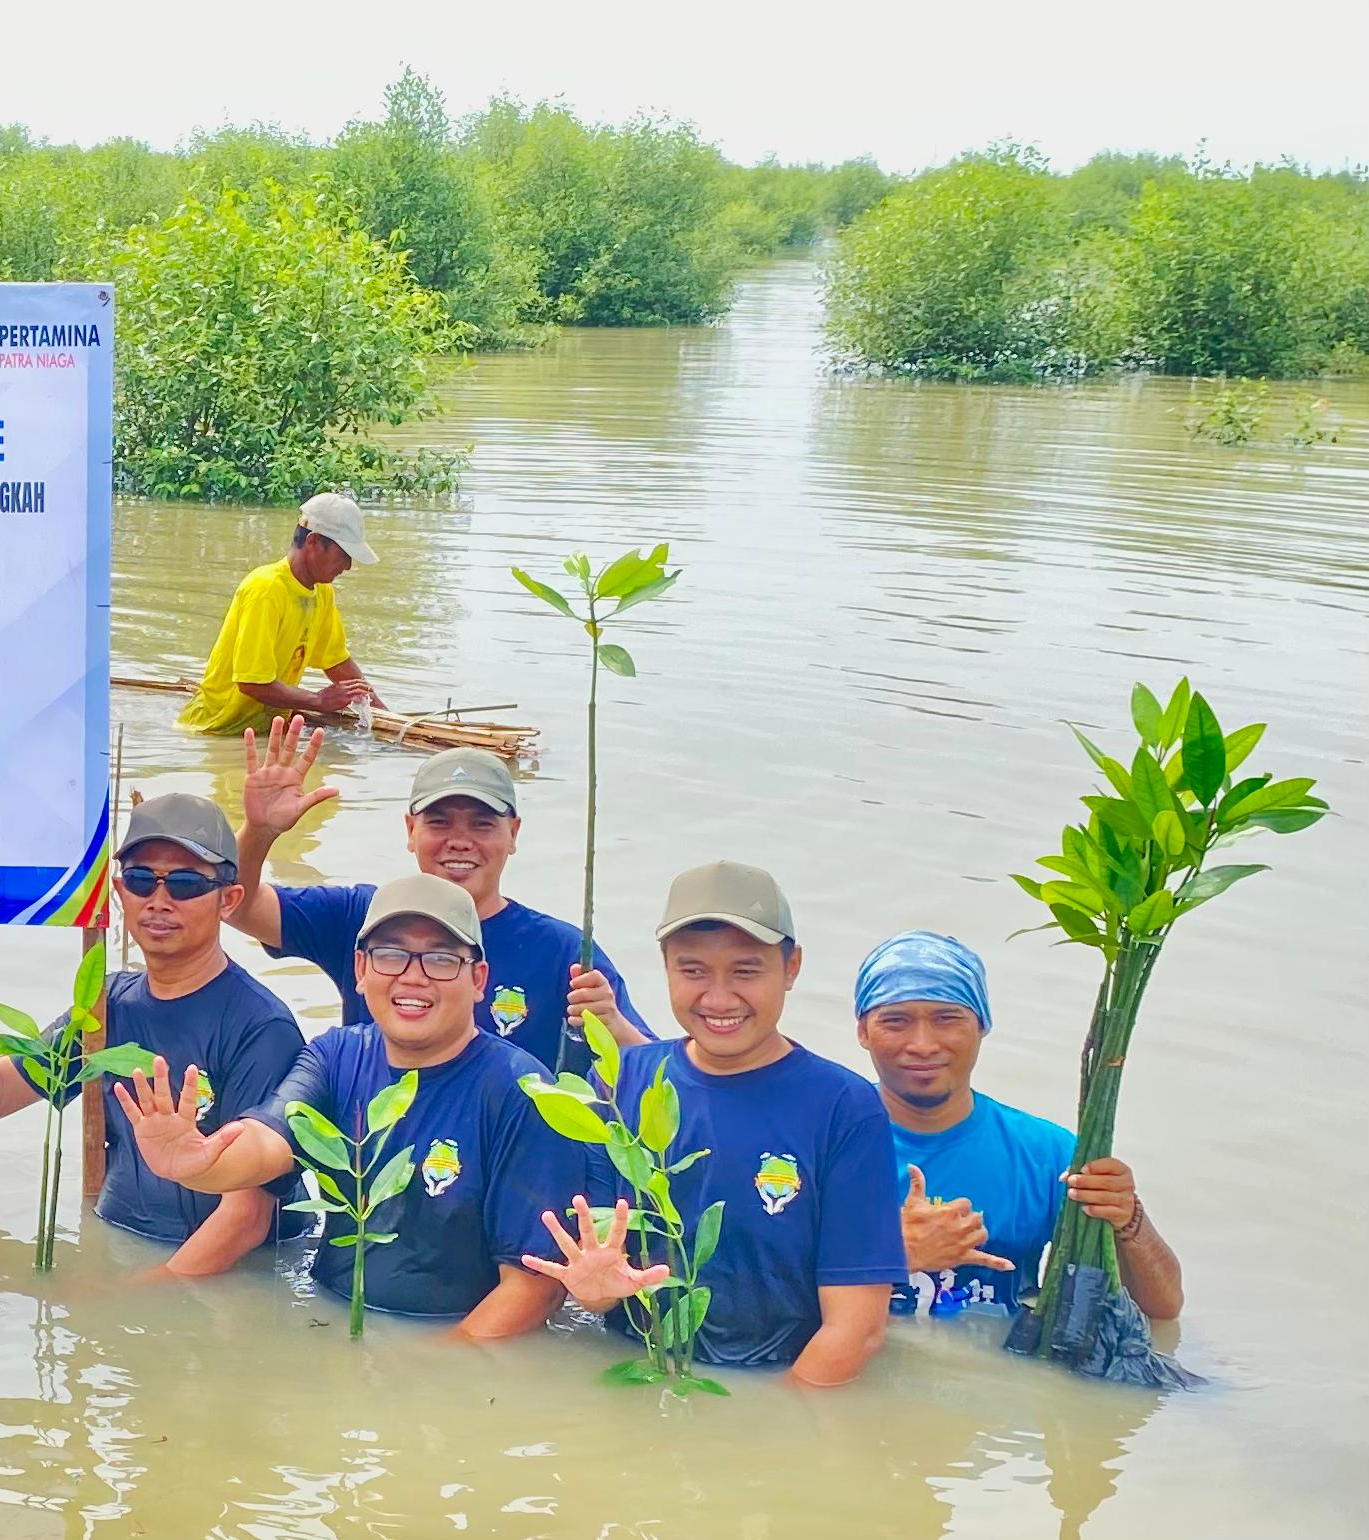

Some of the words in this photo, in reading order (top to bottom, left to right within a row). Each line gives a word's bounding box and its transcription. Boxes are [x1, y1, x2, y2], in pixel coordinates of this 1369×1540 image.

[0, 324, 100, 347] PERTAMINA
[0, 353, 33, 368] PATRA
[36, 353, 75, 368] NIAGA
